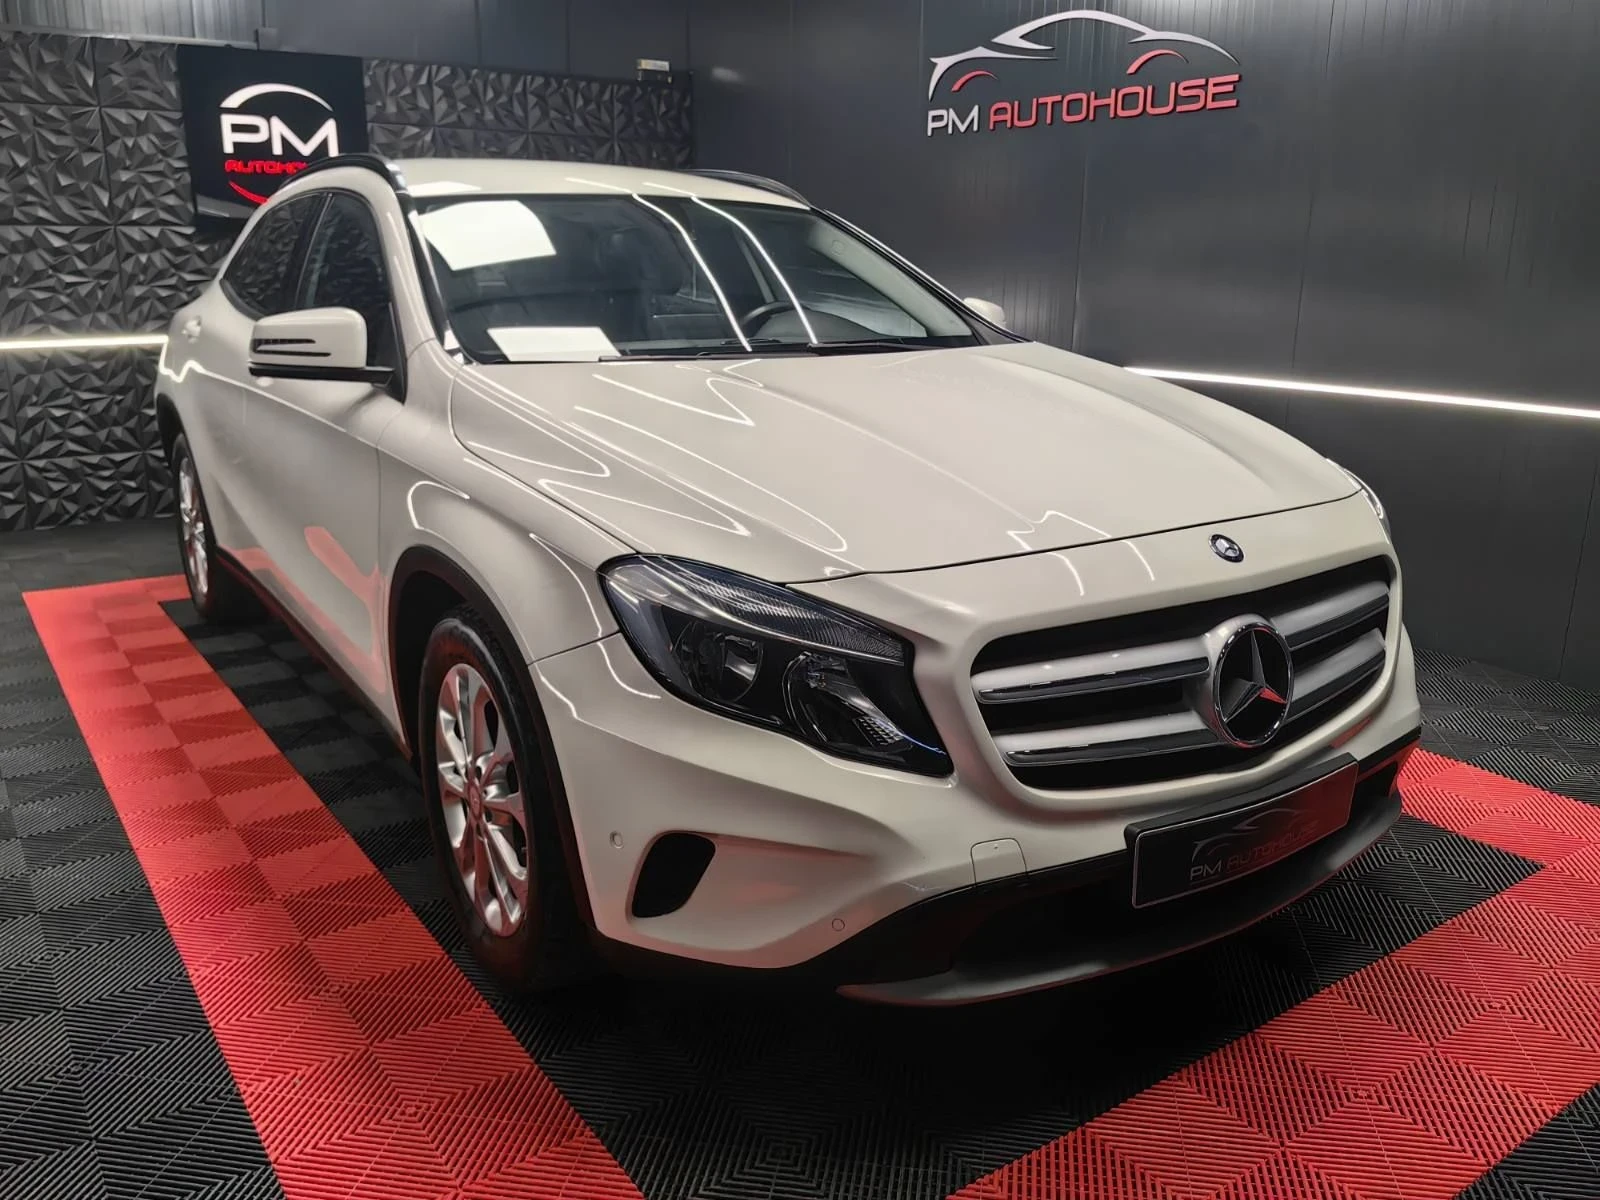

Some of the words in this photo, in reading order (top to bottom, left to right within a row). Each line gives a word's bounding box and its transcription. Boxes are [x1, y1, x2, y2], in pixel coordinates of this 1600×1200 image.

[927, 105, 979, 137] PM
[989, 74, 1240, 130] AUTOHOUSE
[220, 113, 339, 157] PM
[1190, 860, 1223, 880] PM
